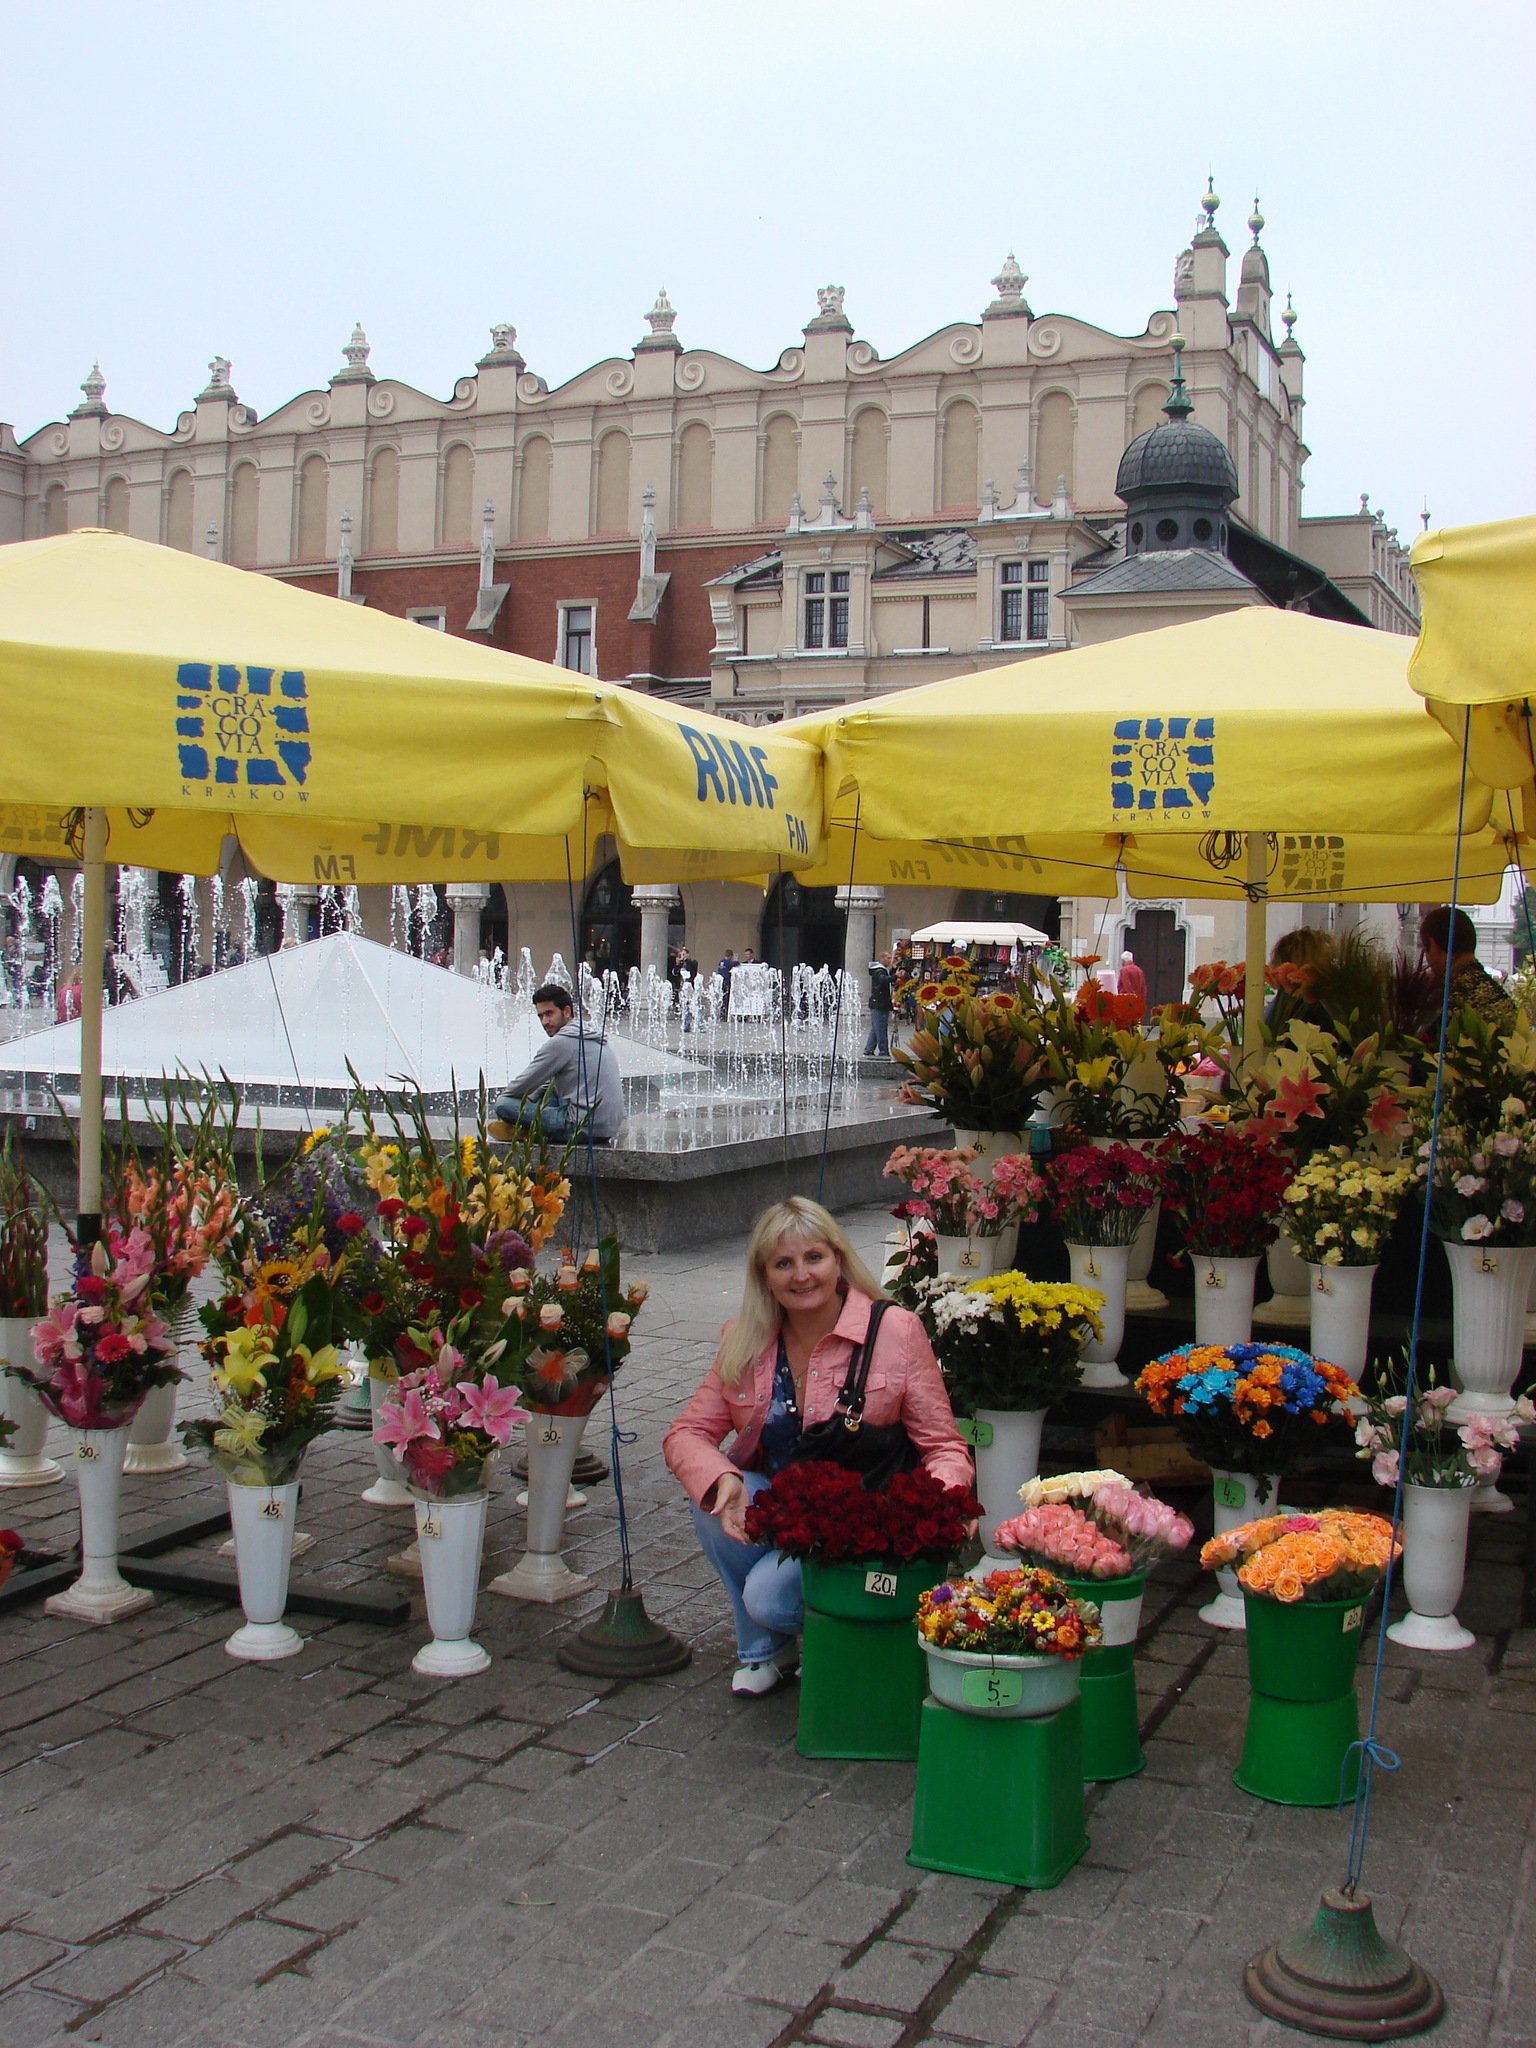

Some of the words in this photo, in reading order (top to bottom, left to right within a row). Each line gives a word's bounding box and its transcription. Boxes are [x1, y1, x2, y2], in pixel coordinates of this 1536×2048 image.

[212, 697, 267, 718] CRA
[219, 716, 262, 737] CO
[215, 733, 264, 754] VIA
[1139, 742, 1181, 759] CRA
[677, 722, 779, 810] RMF
[1143, 757, 1177, 772] CO
[1140, 771, 1177, 786] VIA
[182, 785, 310, 802] KRAKOW
[1112, 810, 1211, 822] KRAKOW
[785, 813, 809, 855] FM
